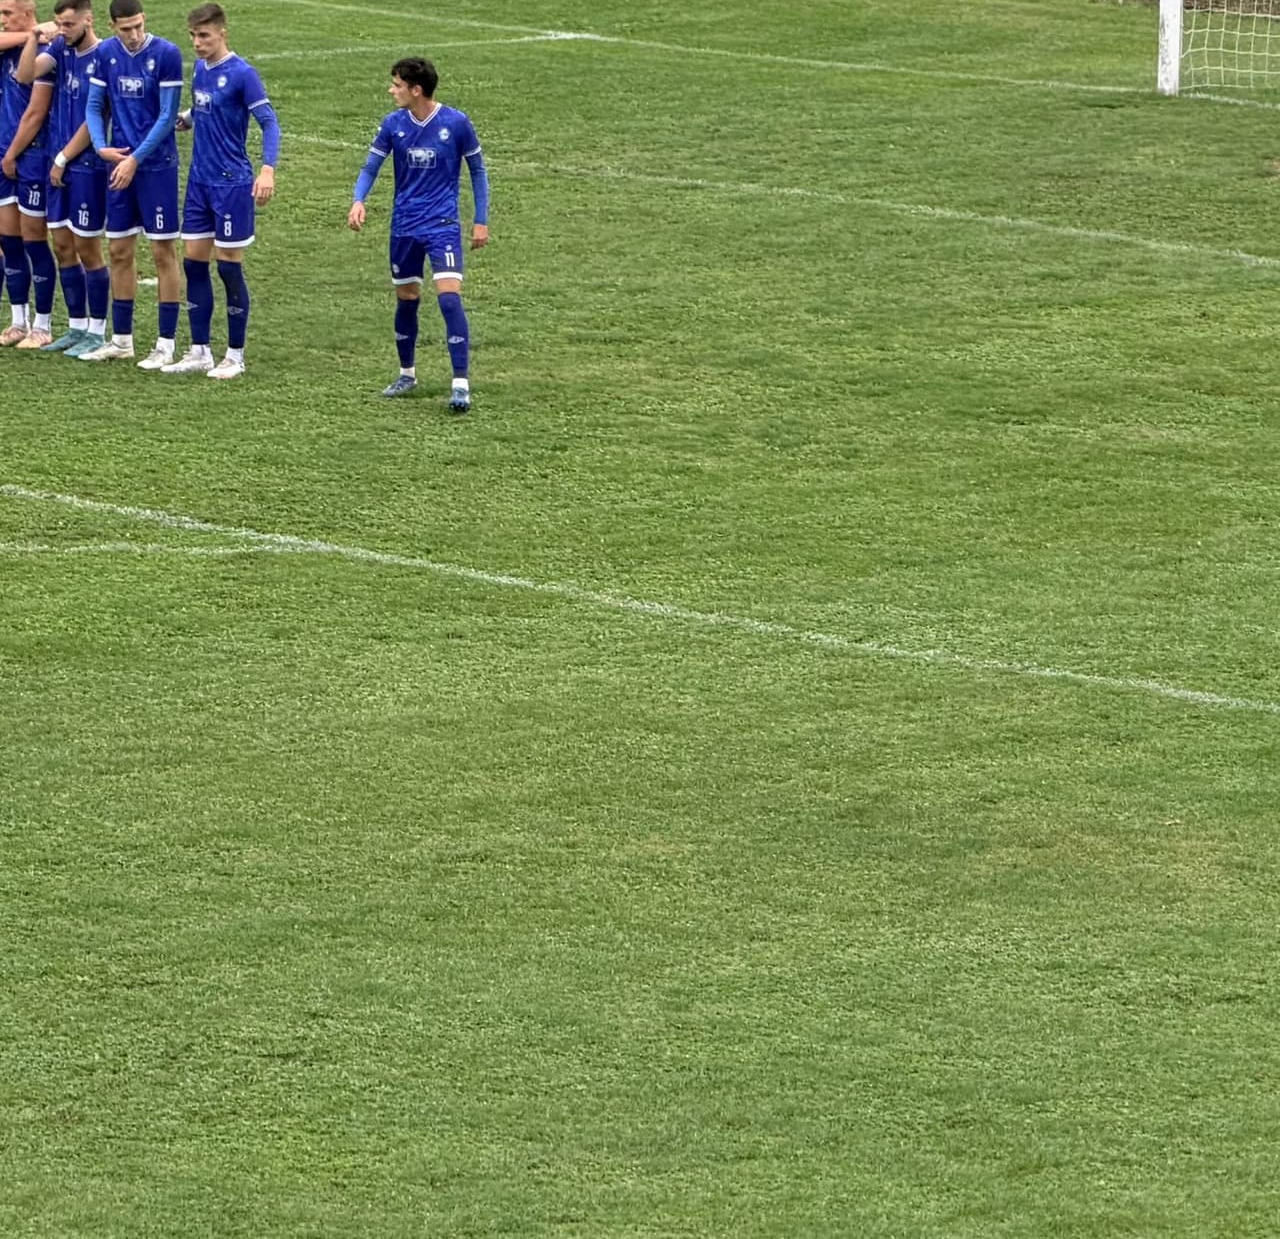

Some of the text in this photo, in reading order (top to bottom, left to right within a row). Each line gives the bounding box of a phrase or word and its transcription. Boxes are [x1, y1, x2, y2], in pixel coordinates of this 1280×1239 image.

[77, 209, 90, 227] 16
[155, 213, 165, 230] 6
[223, 221, 232, 237] 8
[444, 252, 455, 267] 11
